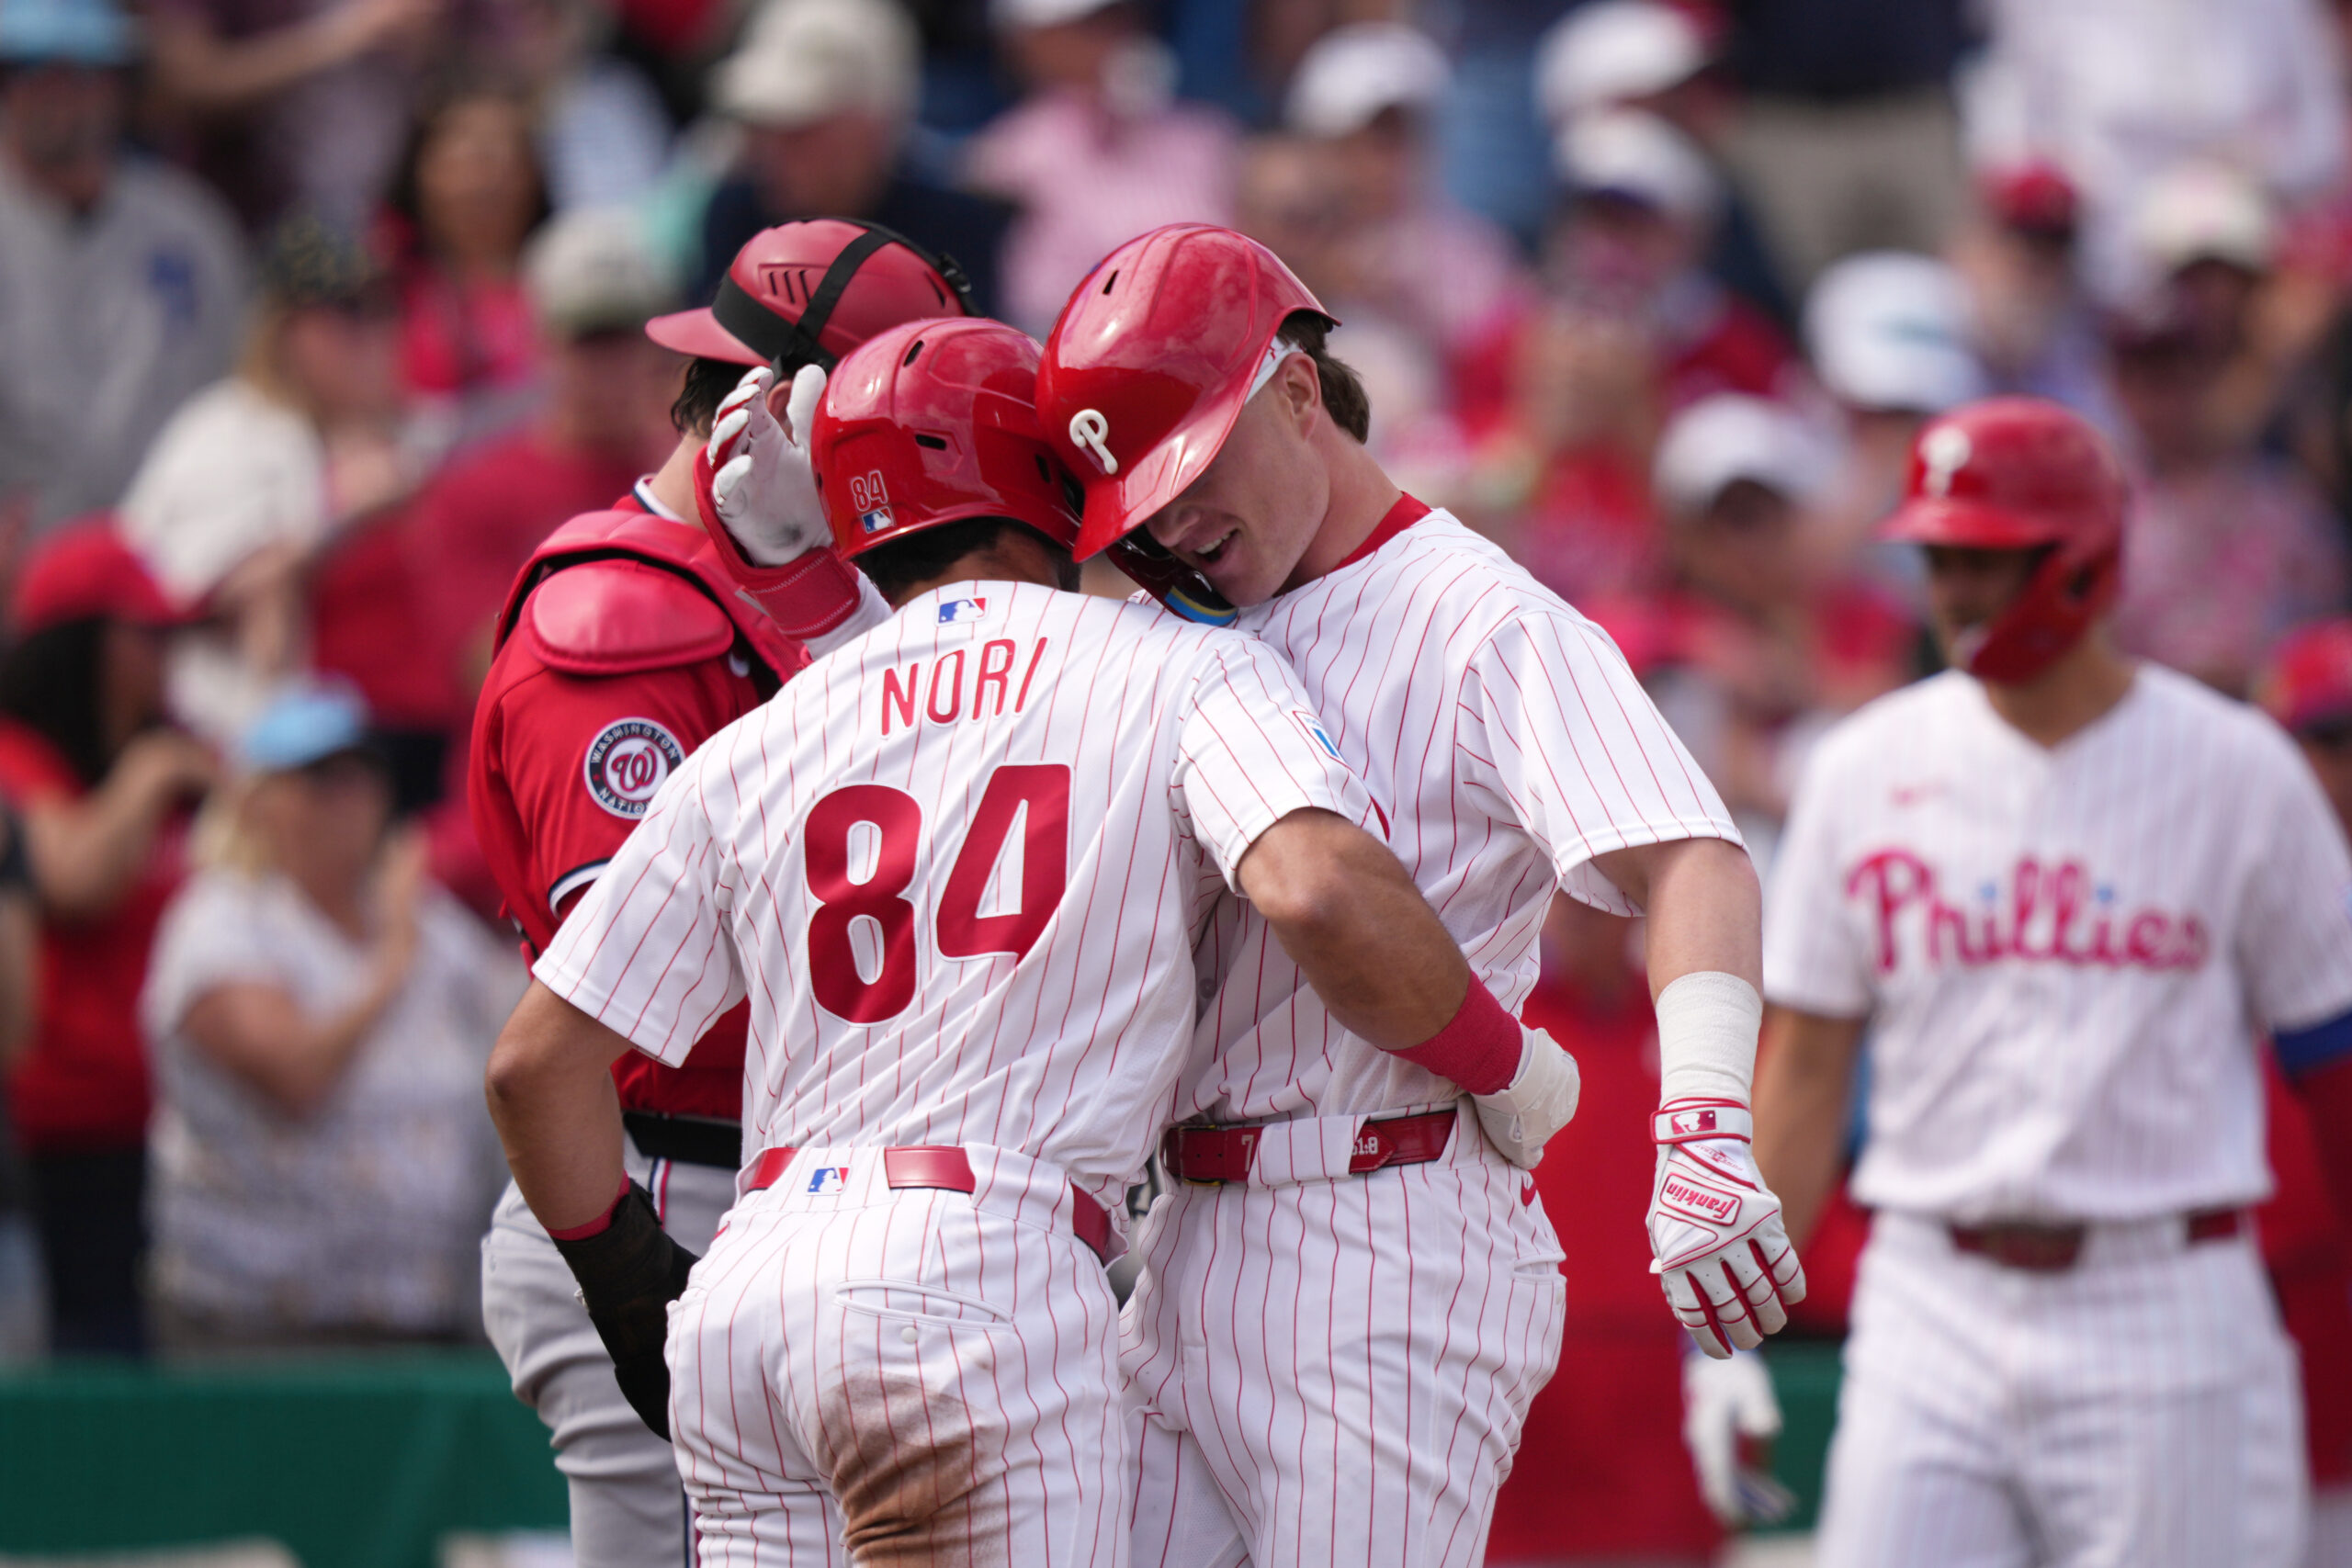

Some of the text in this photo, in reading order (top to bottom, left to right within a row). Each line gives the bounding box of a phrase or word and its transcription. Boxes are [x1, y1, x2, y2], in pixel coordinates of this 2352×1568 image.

[1069, 409, 1118, 475] P
[850, 469, 888, 512] 84
[882, 637, 1048, 737] NORI
[591, 724, 678, 763] WASHINGTON
[598, 787, 650, 814] NATIO
[802, 764, 1071, 1024] 84
[1846, 847, 2209, 974] Phillies
